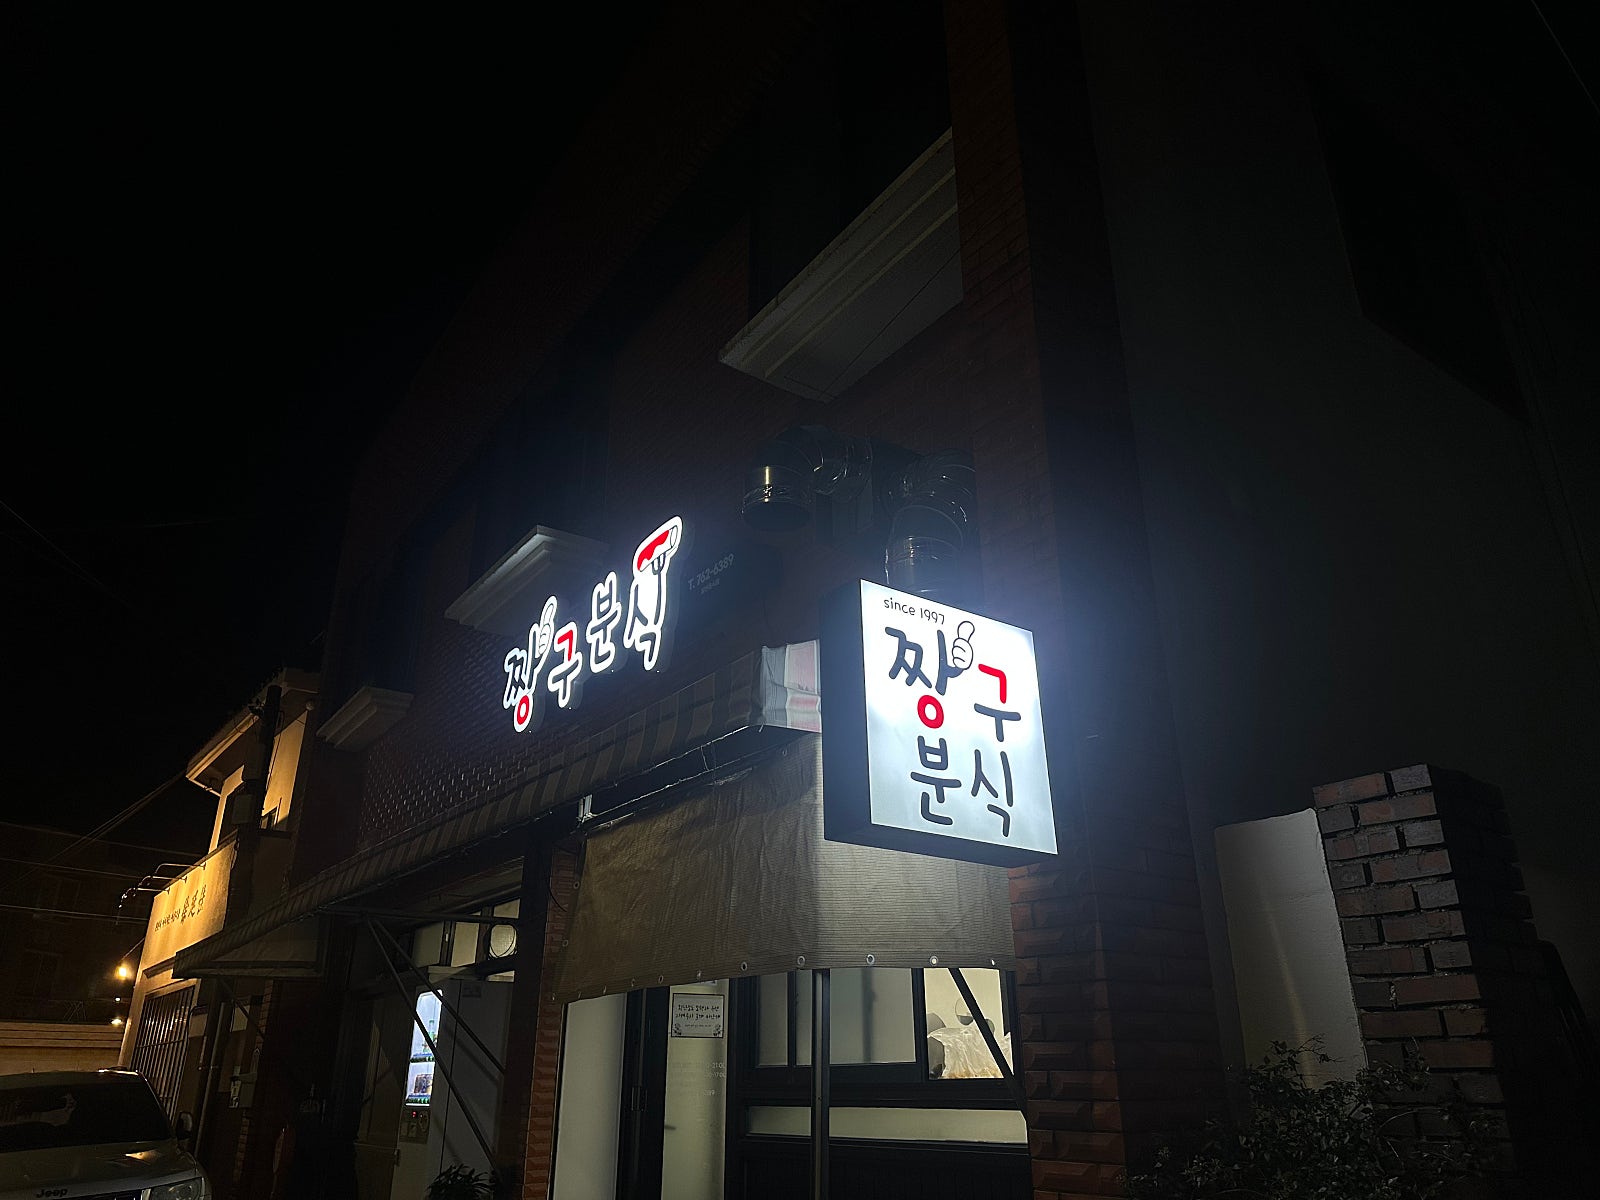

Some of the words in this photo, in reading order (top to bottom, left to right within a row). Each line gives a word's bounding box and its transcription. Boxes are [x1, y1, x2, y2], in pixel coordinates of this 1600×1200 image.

[883, 597, 916, 616] since
[919, 607, 946, 625] 1997
[910, 735, 1014, 838] 분식
[36, 1188, 69, 1198] Jeep
